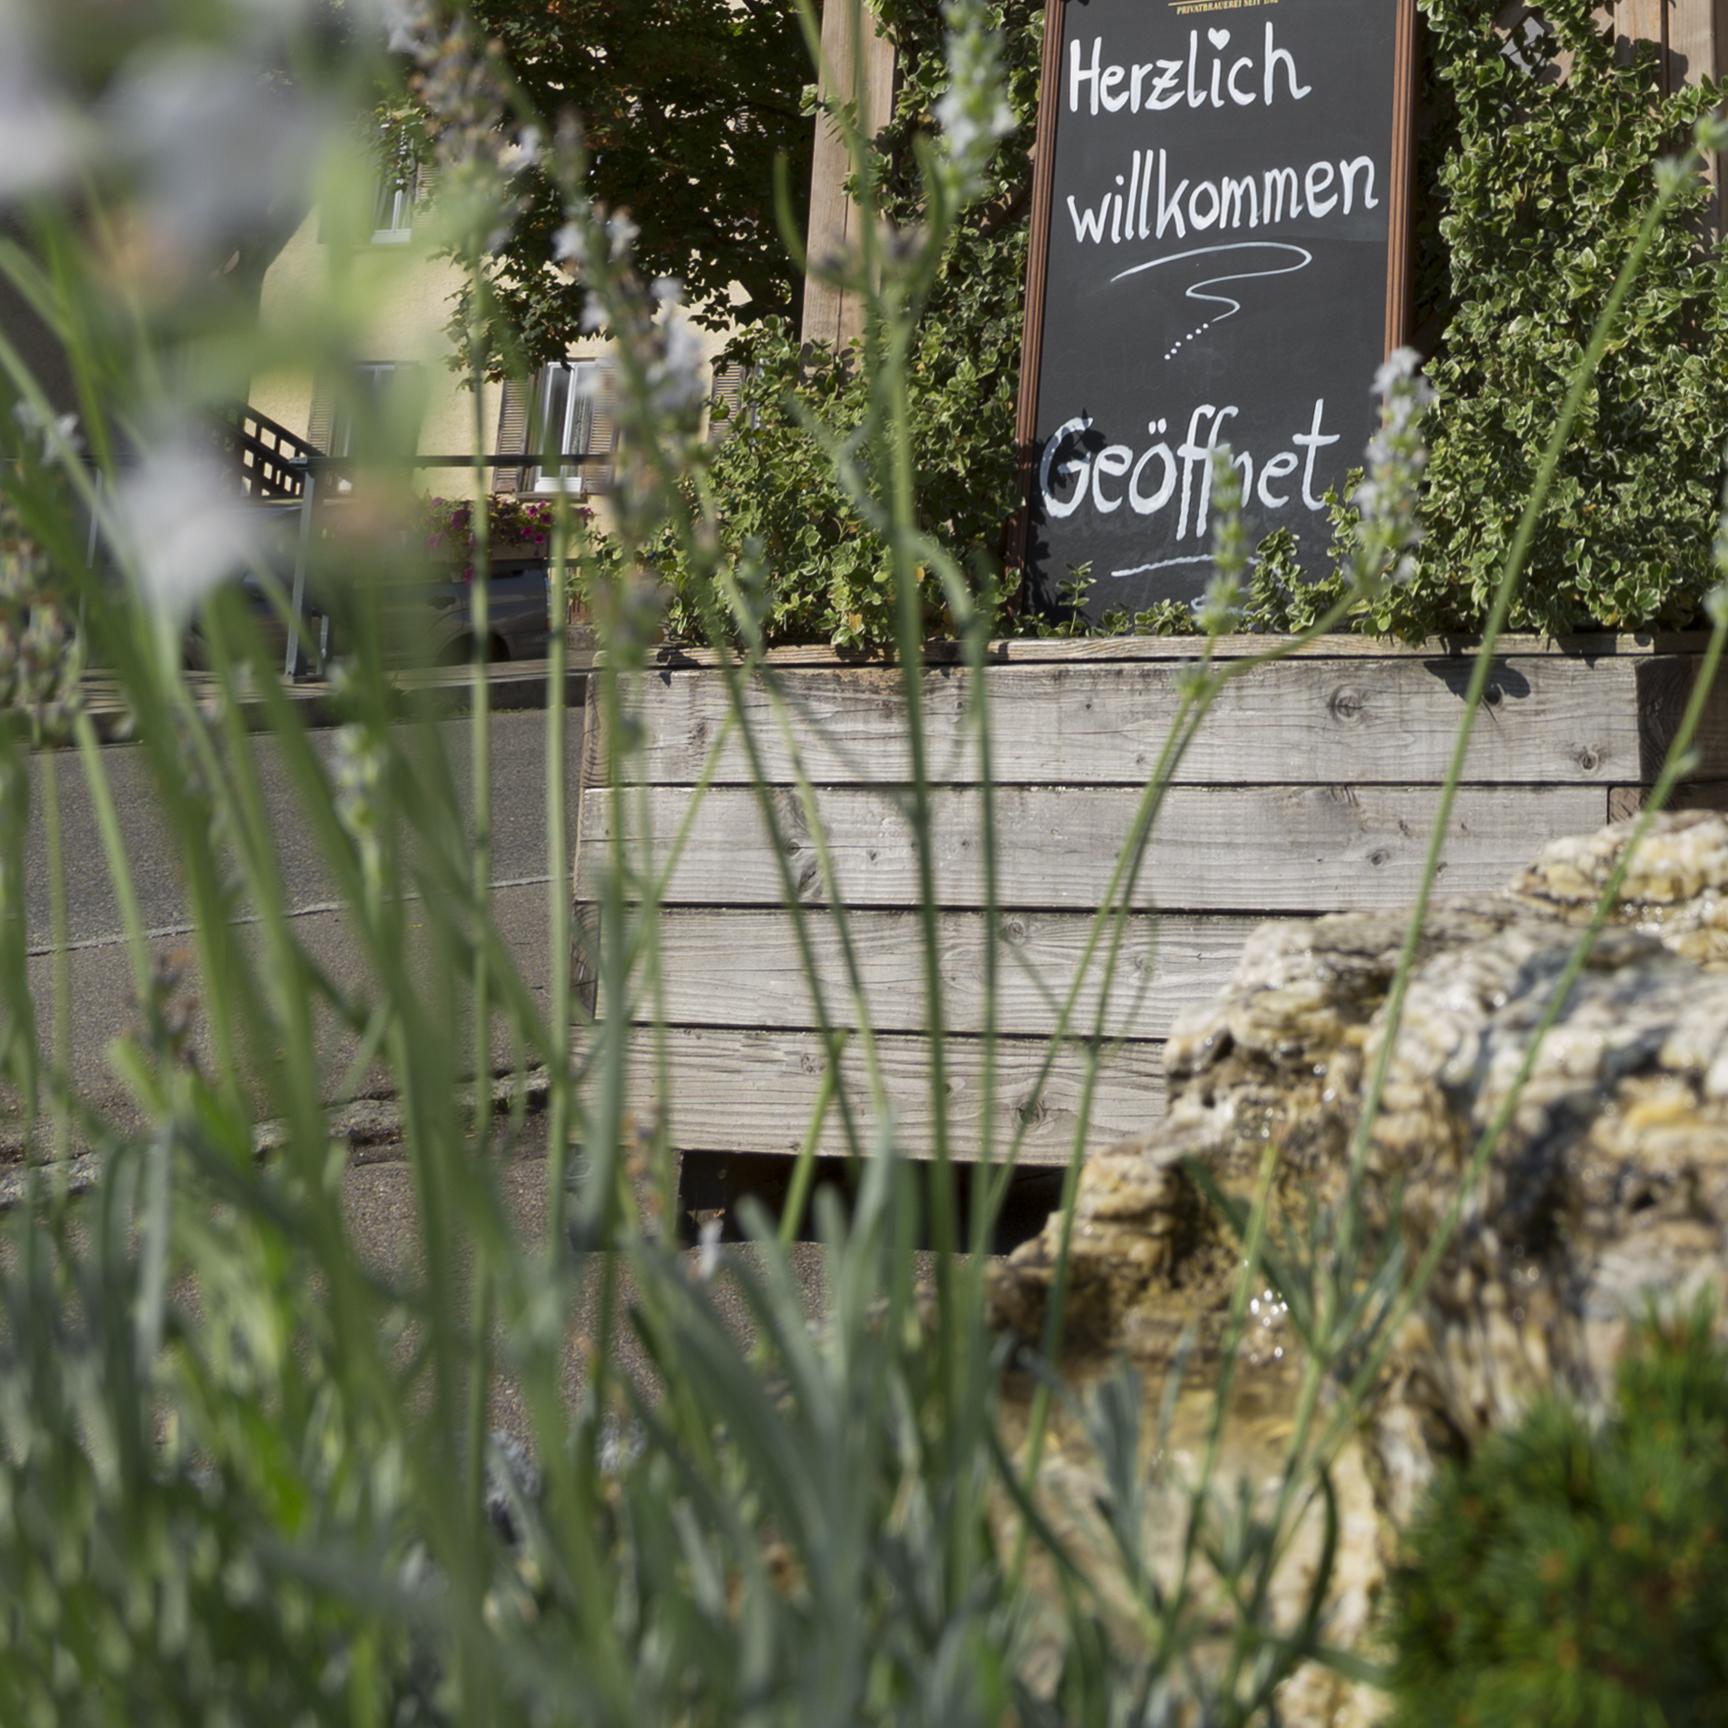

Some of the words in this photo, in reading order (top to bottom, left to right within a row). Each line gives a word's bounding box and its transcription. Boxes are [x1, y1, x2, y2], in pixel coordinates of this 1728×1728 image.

[1176, 0, 1242, 15] PRIVATBRAUEREI
[1069, 20, 1312, 117] Herzlich
[1066, 147, 1379, 244] willkommen
[1039, 397, 1342, 542] Geöffnet
